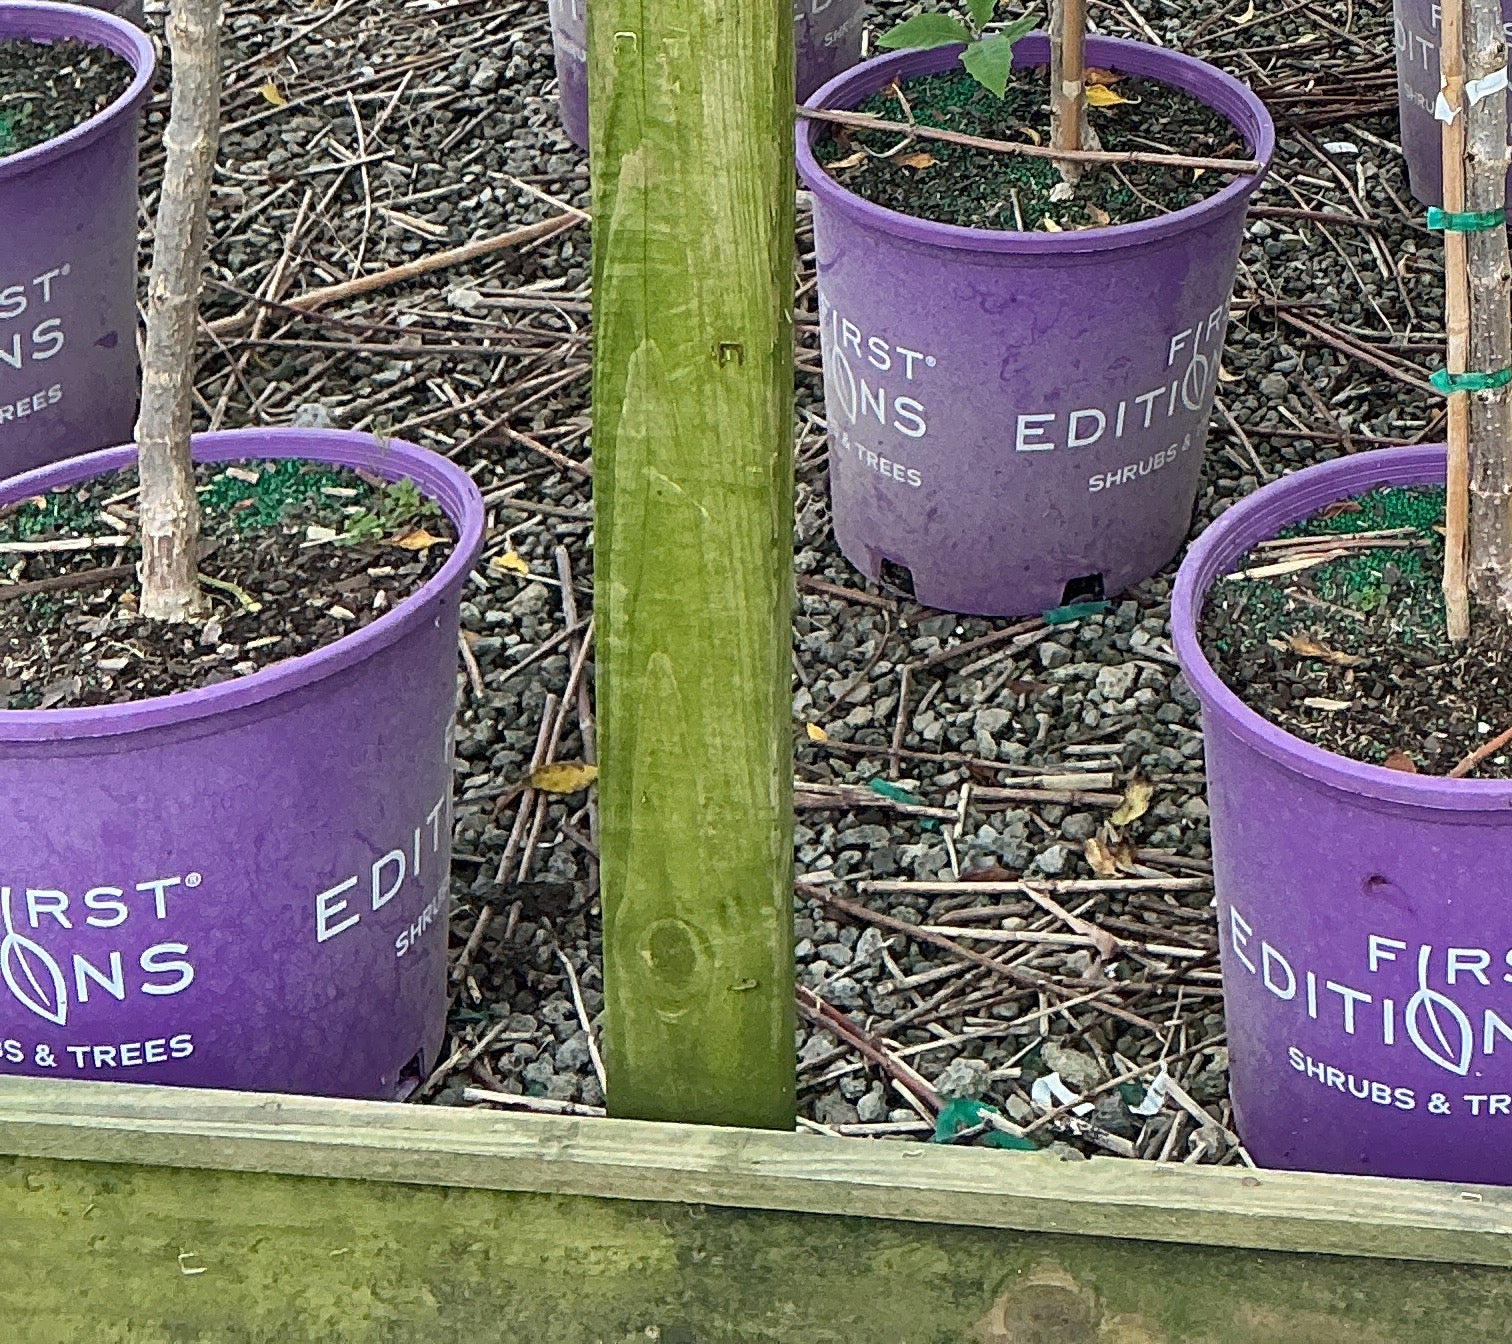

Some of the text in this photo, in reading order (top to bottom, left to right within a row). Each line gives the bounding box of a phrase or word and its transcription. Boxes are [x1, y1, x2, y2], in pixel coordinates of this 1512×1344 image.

[1168, 305, 1224, 366] FIR
[0, 383, 63, 425] REES
[1016, 350, 1214, 452] EDITIO
[855, 442, 922, 488] TREES
[1089, 443, 1178, 494] SHRUBS
[316, 795, 445, 943] EDIT
[0, 872, 202, 934] IRST®
[34, 1033, 195, 1069] & TREES
[1288, 1045, 1416, 1112] SHRUBS
[1427, 1092, 1452, 1114] &
